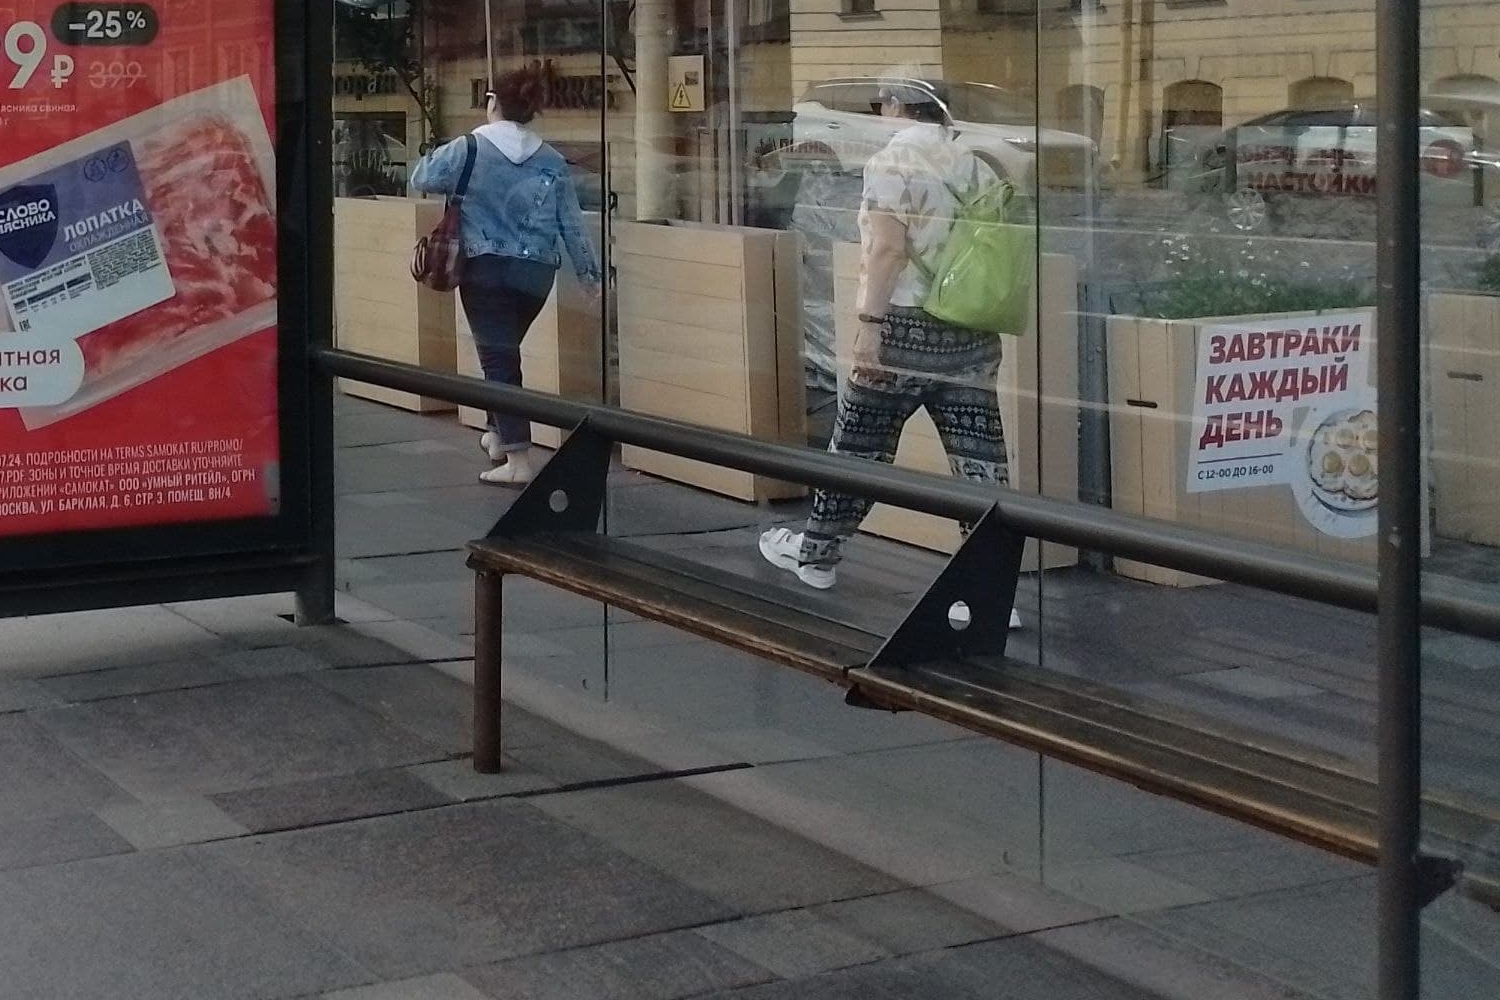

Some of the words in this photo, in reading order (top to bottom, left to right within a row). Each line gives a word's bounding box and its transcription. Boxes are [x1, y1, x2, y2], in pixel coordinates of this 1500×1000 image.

[69, 10, 146, 38] -25%
[89, 61, 143, 89] 399
[63, 198, 146, 242] ЛОПАТКА
[1208, 323, 1362, 365] ЗАВТРАКИ
[1205, 356, 1349, 404] КАЖДЫЙ
[1199, 409, 1283, 450] ДЕНЬ
[26, 448, 98, 466] ПОДРОБНОСТИ
[100, 447, 113, 461] НА
[28, 466, 57, 482] ЗОНЫ
[60, 466, 67, 479] И
[69, 464, 106, 479] ТОЧНОЕ
[108, 461, 140, 477] ВРЕМЯ
[142, 457, 191, 475] ДОСТАВКИ
[119, 477, 140, 491] ООО
[142, 472, 183, 491] «УМНЫЙ
[185, 469, 230, 486] РИТЕЙЛ»,
[231, 468, 256, 483] ОГРН
[1197, 470, 1204, 480] С
[1206, 468, 1232, 479] 12-00
[1232, 466, 1247, 478] ДО
[1249, 464, 1274, 476] 16-00
[59, 496, 109, 511] БАРКЛАЯ,
